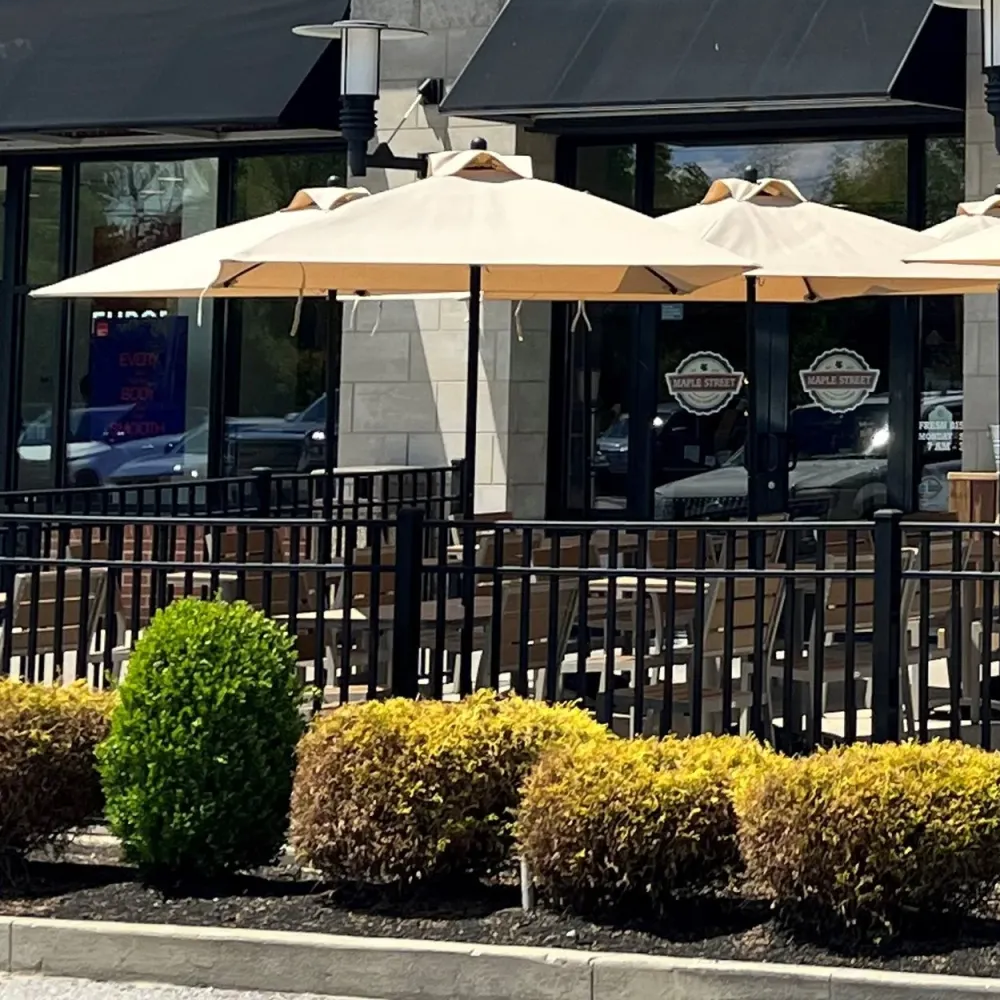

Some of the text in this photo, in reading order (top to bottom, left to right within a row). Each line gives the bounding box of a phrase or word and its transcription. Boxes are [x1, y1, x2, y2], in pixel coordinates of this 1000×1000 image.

[673, 377, 736, 388] MAPLE STREET
[807, 375, 872, 385] MAPLE STREET
